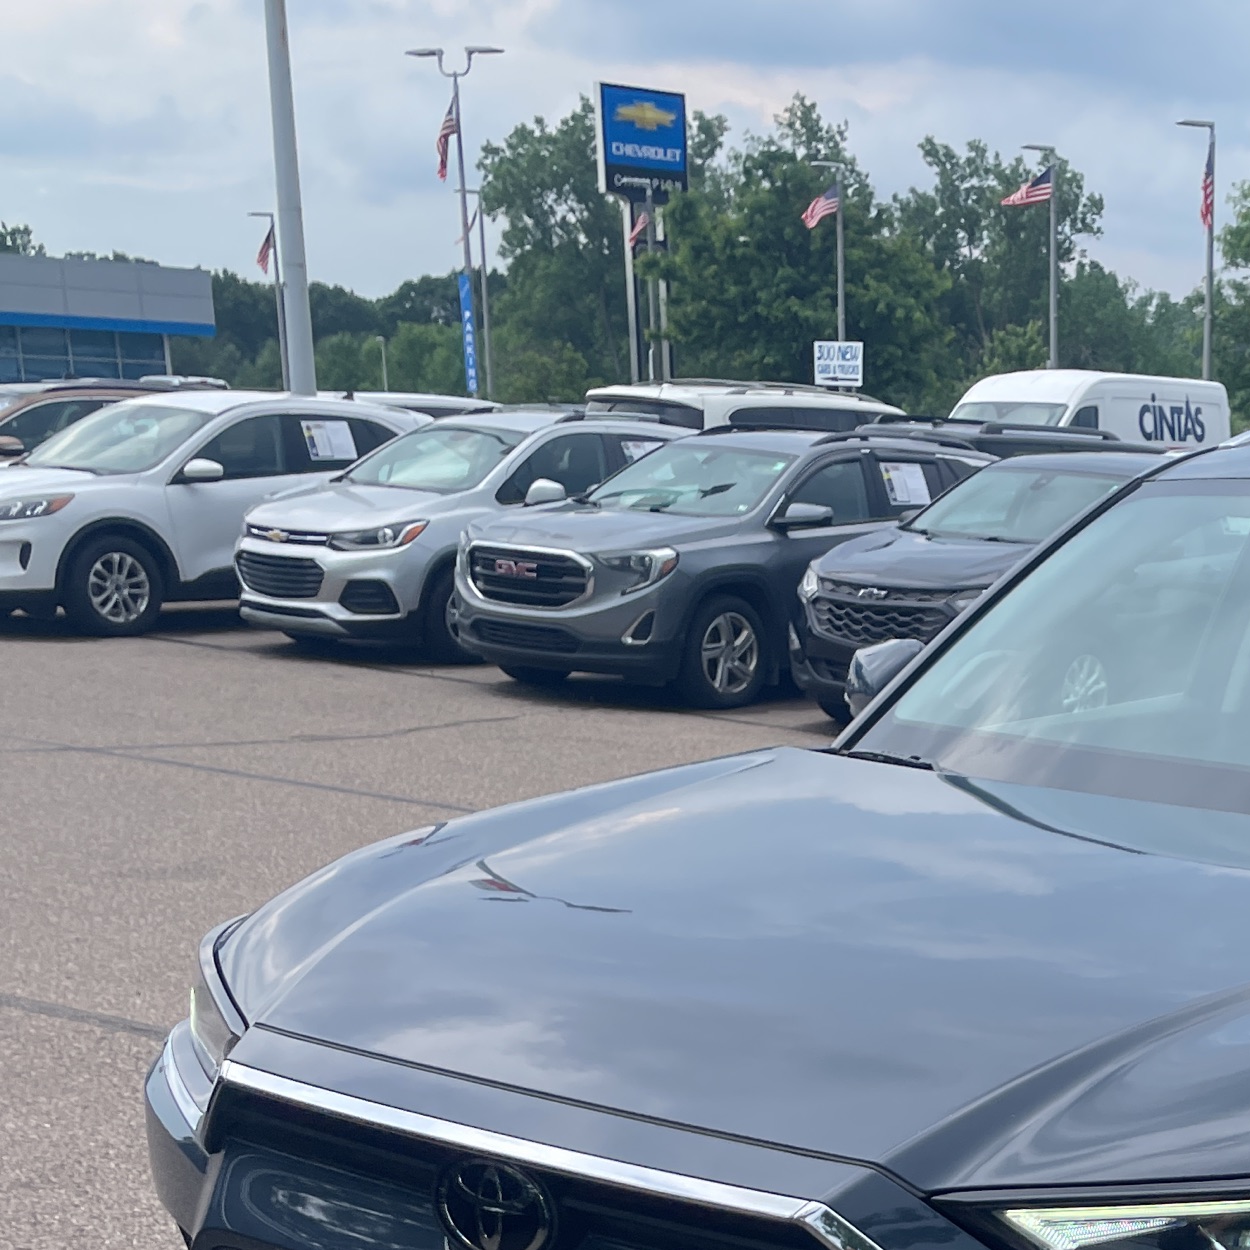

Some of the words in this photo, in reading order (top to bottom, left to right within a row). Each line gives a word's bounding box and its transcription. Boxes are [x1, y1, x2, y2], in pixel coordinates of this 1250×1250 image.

[611, 141, 681, 162] CHEVROLET
[463, 310, 477, 390] PARKING
[817, 345, 836, 361] 300
[837, 345, 860, 362] NEW
[1139, 392, 1205, 443] CINTAS
[495, 559, 538, 580] GMC
